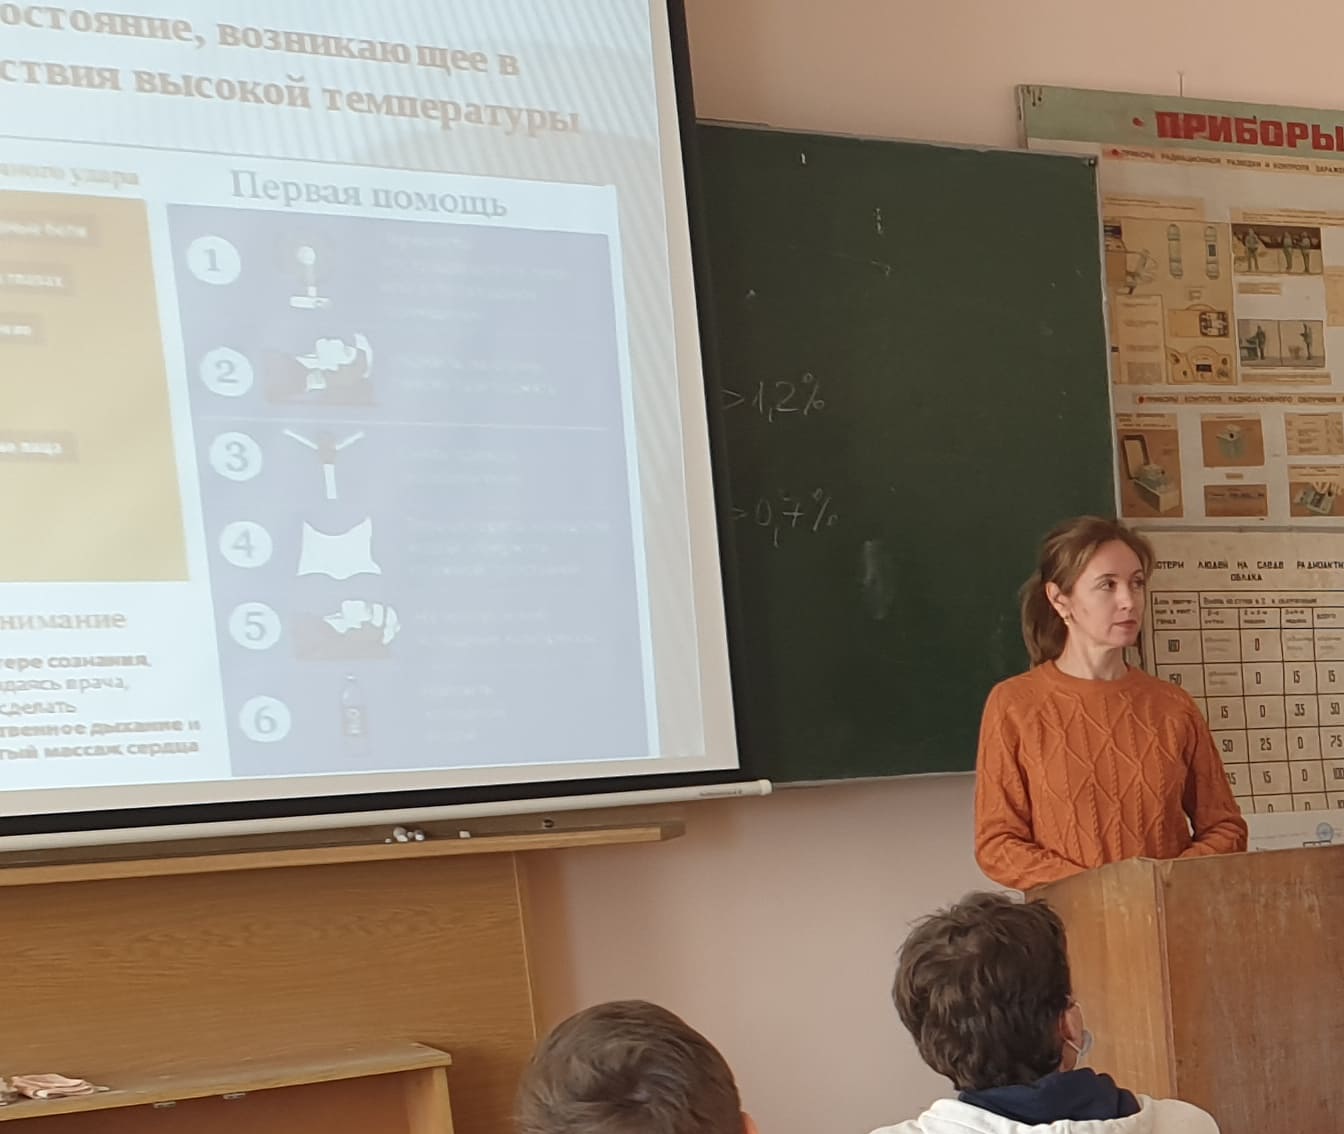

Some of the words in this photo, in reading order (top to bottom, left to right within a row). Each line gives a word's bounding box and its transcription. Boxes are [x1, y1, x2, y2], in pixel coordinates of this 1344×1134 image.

[217, 22, 487, 76] возникающее
[497, 52, 520, 77] в
[135, 69, 309, 110] высокой
[323, 87, 581, 136] температуры
[1155, 111, 1344, 152] ПРИБОРЫ
[230, 169, 361, 209] Первая
[372, 187, 507, 219] помощь
[202, 247, 221, 272] 1
[214, 359, 237, 384] 2
[225, 442, 247, 471] 3
[231, 530, 254, 558] 4
[1153, 561, 1184, 569] ОТЕРИ
[1197, 559, 1228, 569] ЛЮДЕЙ
[1237, 561, 1248, 569] НА
[1257, 561, 1284, 569] СЛЕДЕ
[1230, 573, 1262, 582] ОБЛАКА
[244, 611, 267, 641] 5
[1254, 638, 1260, 651] 0
[1256, 672, 1261, 684] 0
[1293, 670, 1300, 684] 15
[1328, 670, 1335, 683] 15
[253, 706, 275, 735] 6
[1221, 706, 1229, 719] 15
[1260, 705, 1265, 717] 0
[1294, 704, 1305, 717] 35
[1330, 702, 1340, 715] 50
[90, 720, 183, 736] дыхание
[188, 721, 200, 730] и
[44, 745, 124, 757] массаж
[126, 742, 199, 757] сердца
[1222, 739, 1233, 752] 50
[1260, 738, 1272, 751] 25
[1298, 737, 1303, 749] 0
[1330, 735, 1342, 747] 75
[1263, 770, 1272, 783] 15
[1302, 769, 1308, 781] 0
